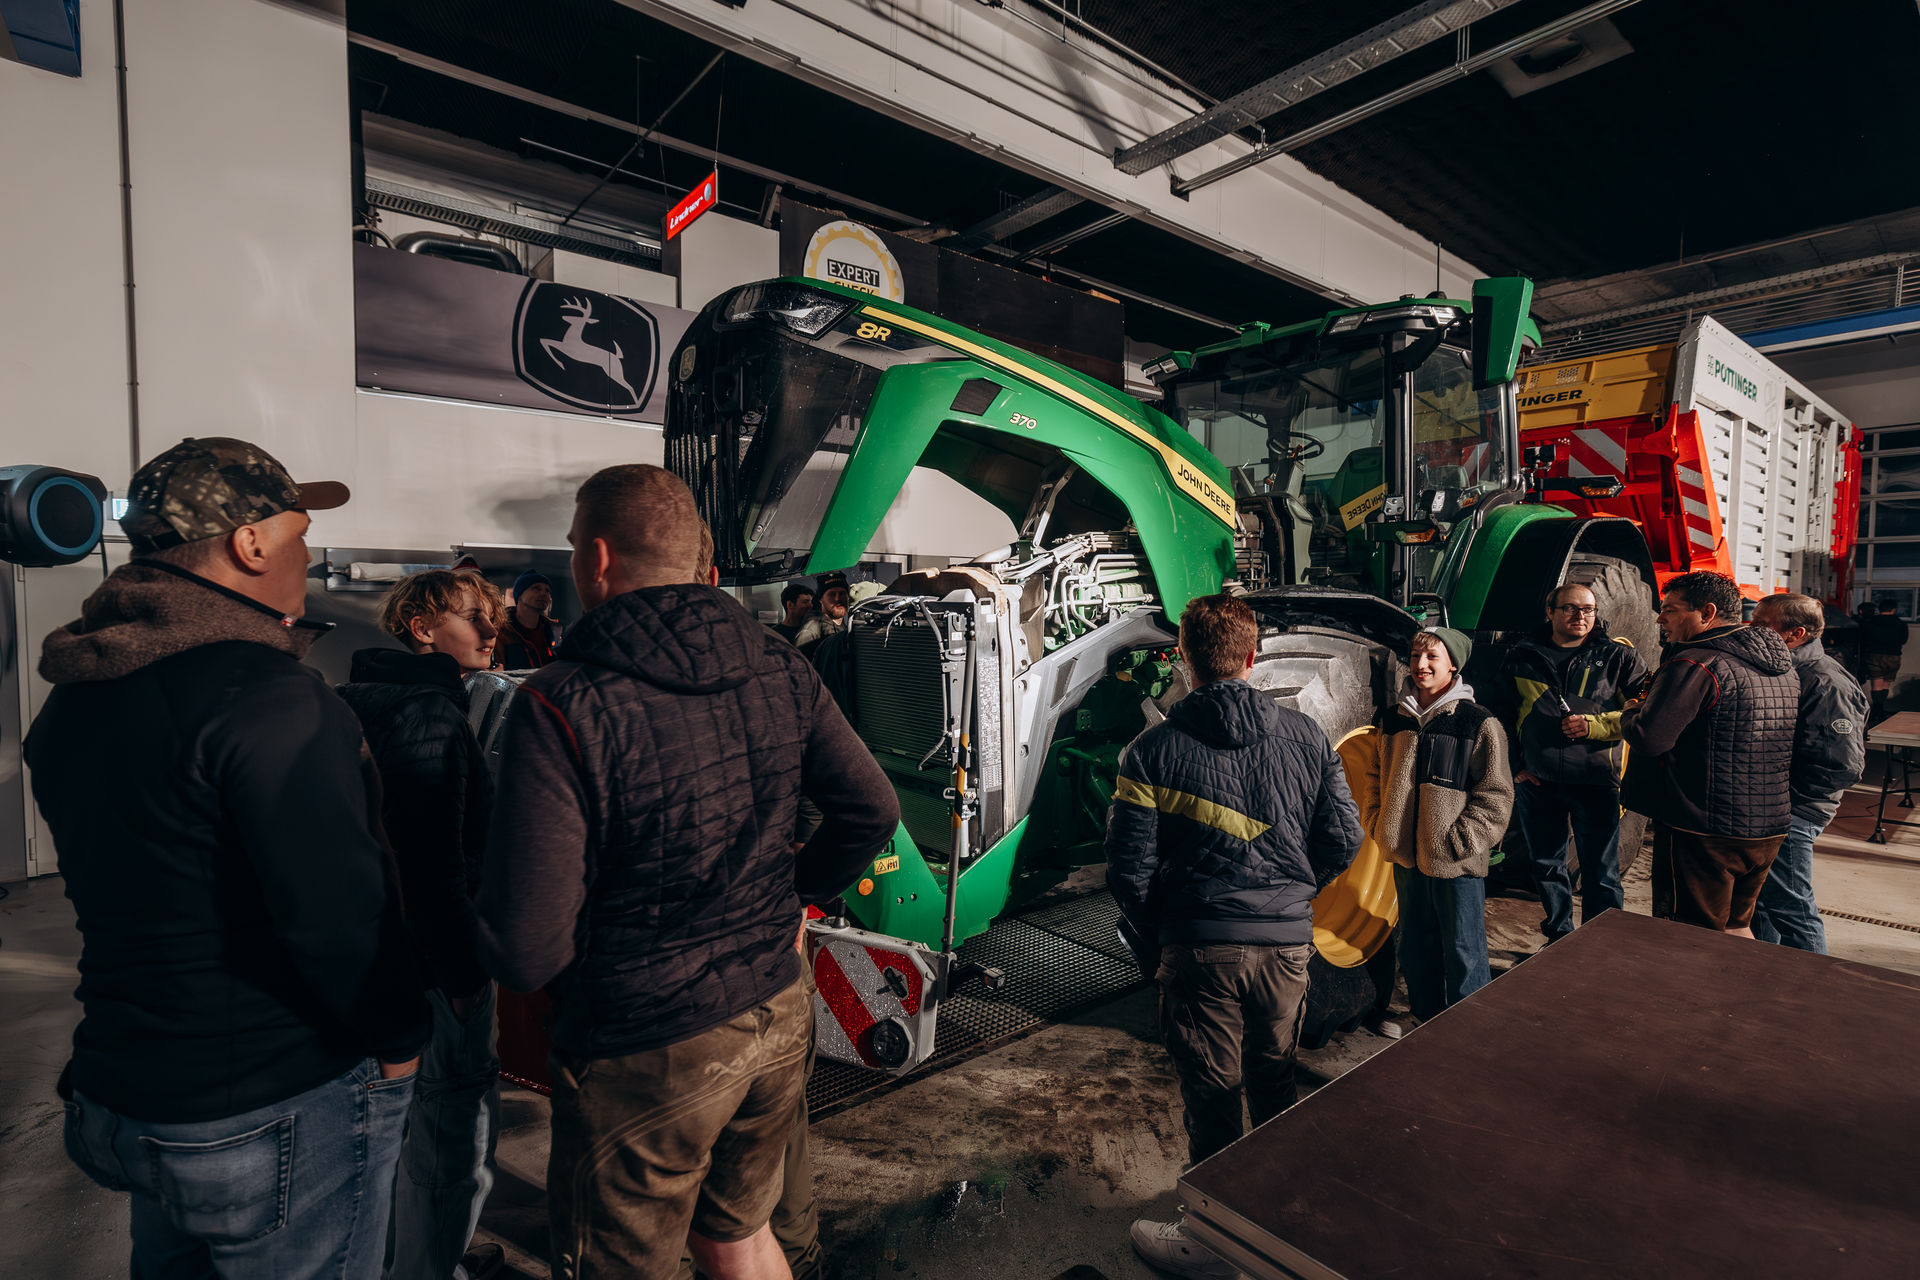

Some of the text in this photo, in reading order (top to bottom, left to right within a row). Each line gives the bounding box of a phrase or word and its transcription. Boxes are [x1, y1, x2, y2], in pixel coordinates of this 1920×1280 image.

[670, 196, 704, 230] Lindner
[828, 260, 879, 286] EXPERT
[856, 322, 892, 342] 8R
[1009, 411, 1038, 430] 370
[1178, 463, 1231, 516] JOHN DEERE
